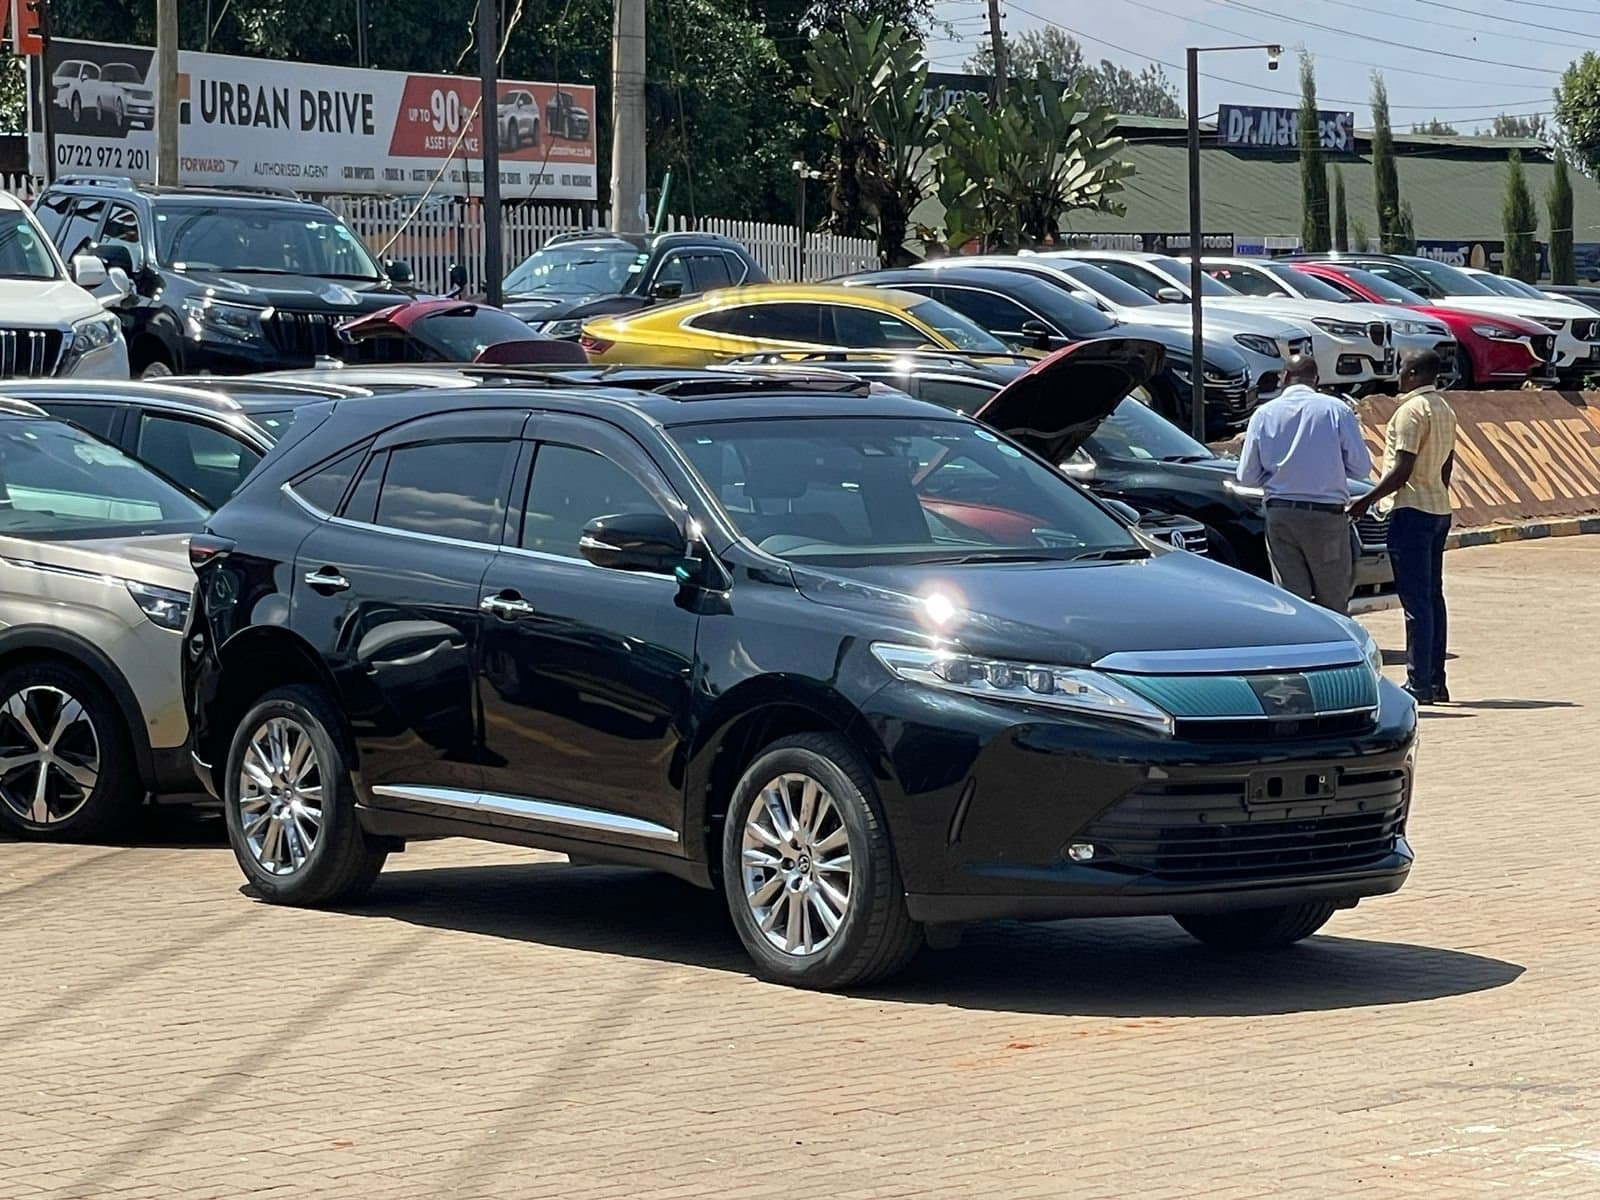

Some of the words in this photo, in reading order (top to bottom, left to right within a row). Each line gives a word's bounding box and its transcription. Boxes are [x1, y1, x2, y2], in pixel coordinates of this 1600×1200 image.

[200, 79, 290, 129] URBAN
[300, 89, 375, 136] DRIVE
[408, 108, 419, 122] UP
[420, 108, 431, 122] TO
[424, 135, 446, 150] ASSET
[57, 143, 92, 167] 0722
[96, 146, 123, 169] 972
[127, 149, 150, 170] 201
[181, 157, 225, 173] FORWARD
[254, 161, 300, 177] AUTHORISED
[303, 165, 329, 179] AGENT
